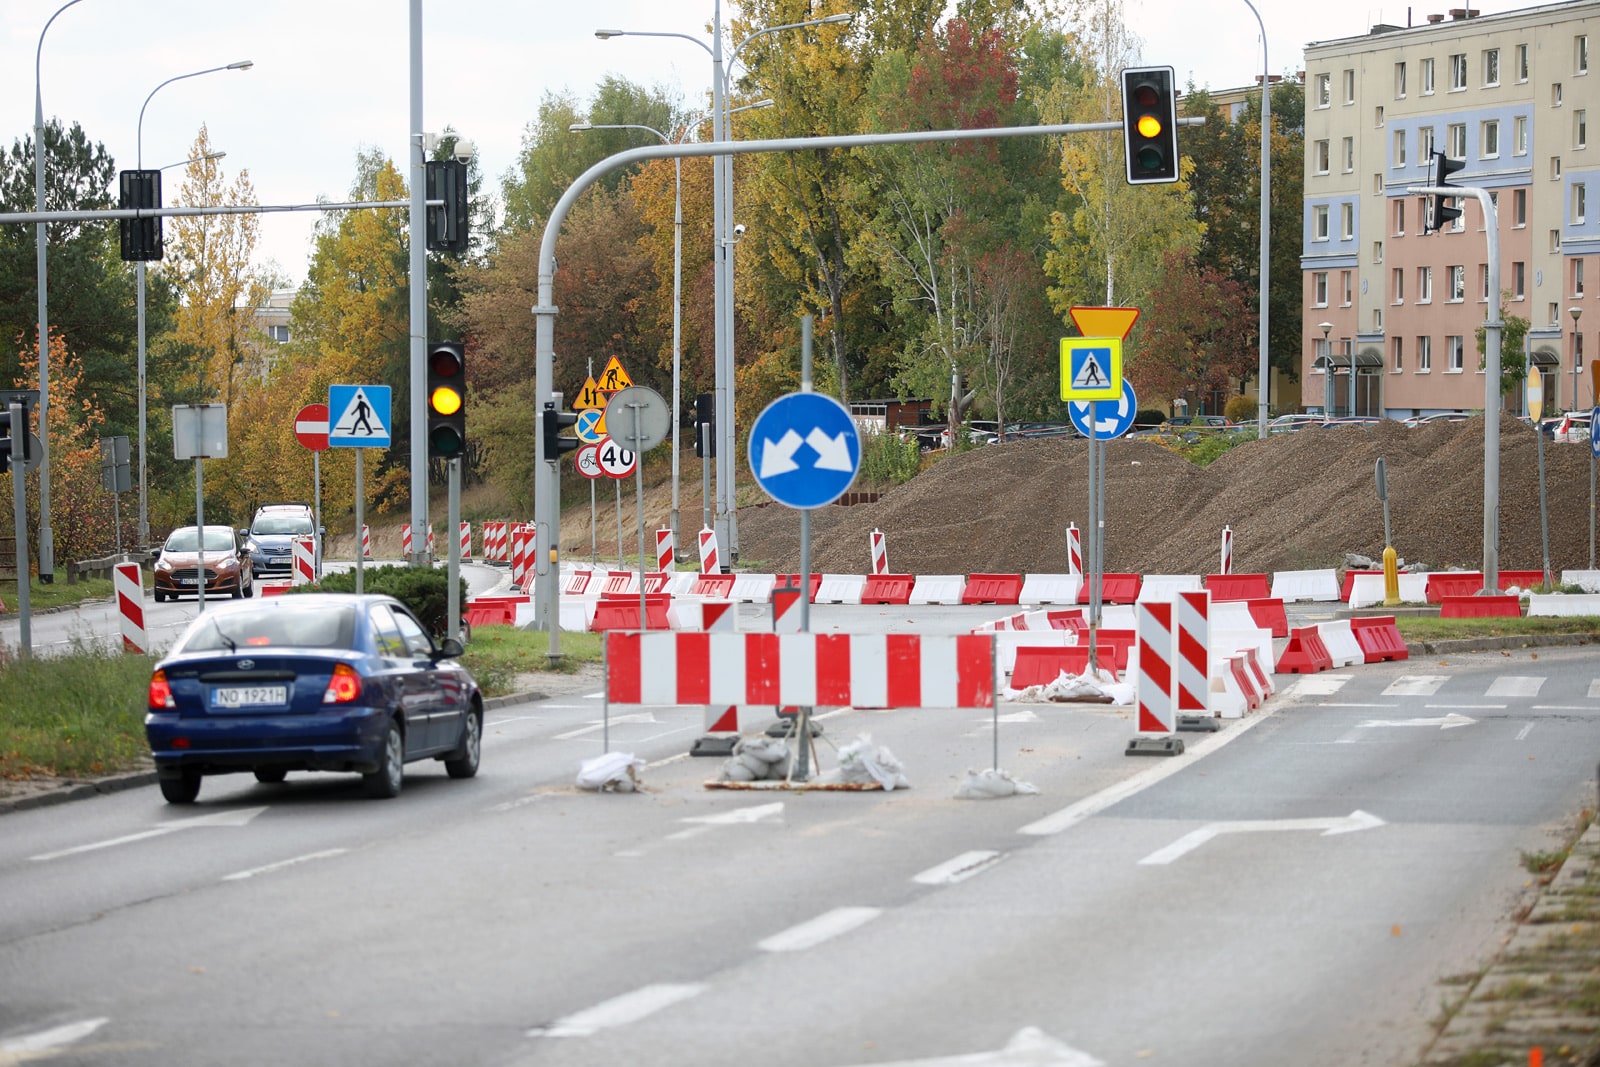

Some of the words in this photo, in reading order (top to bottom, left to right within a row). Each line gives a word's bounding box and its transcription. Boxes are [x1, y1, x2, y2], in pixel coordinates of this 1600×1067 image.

[602, 446, 633, 467] 40
[219, 690, 239, 703] NO
[244, 687, 285, 703] 1921H
